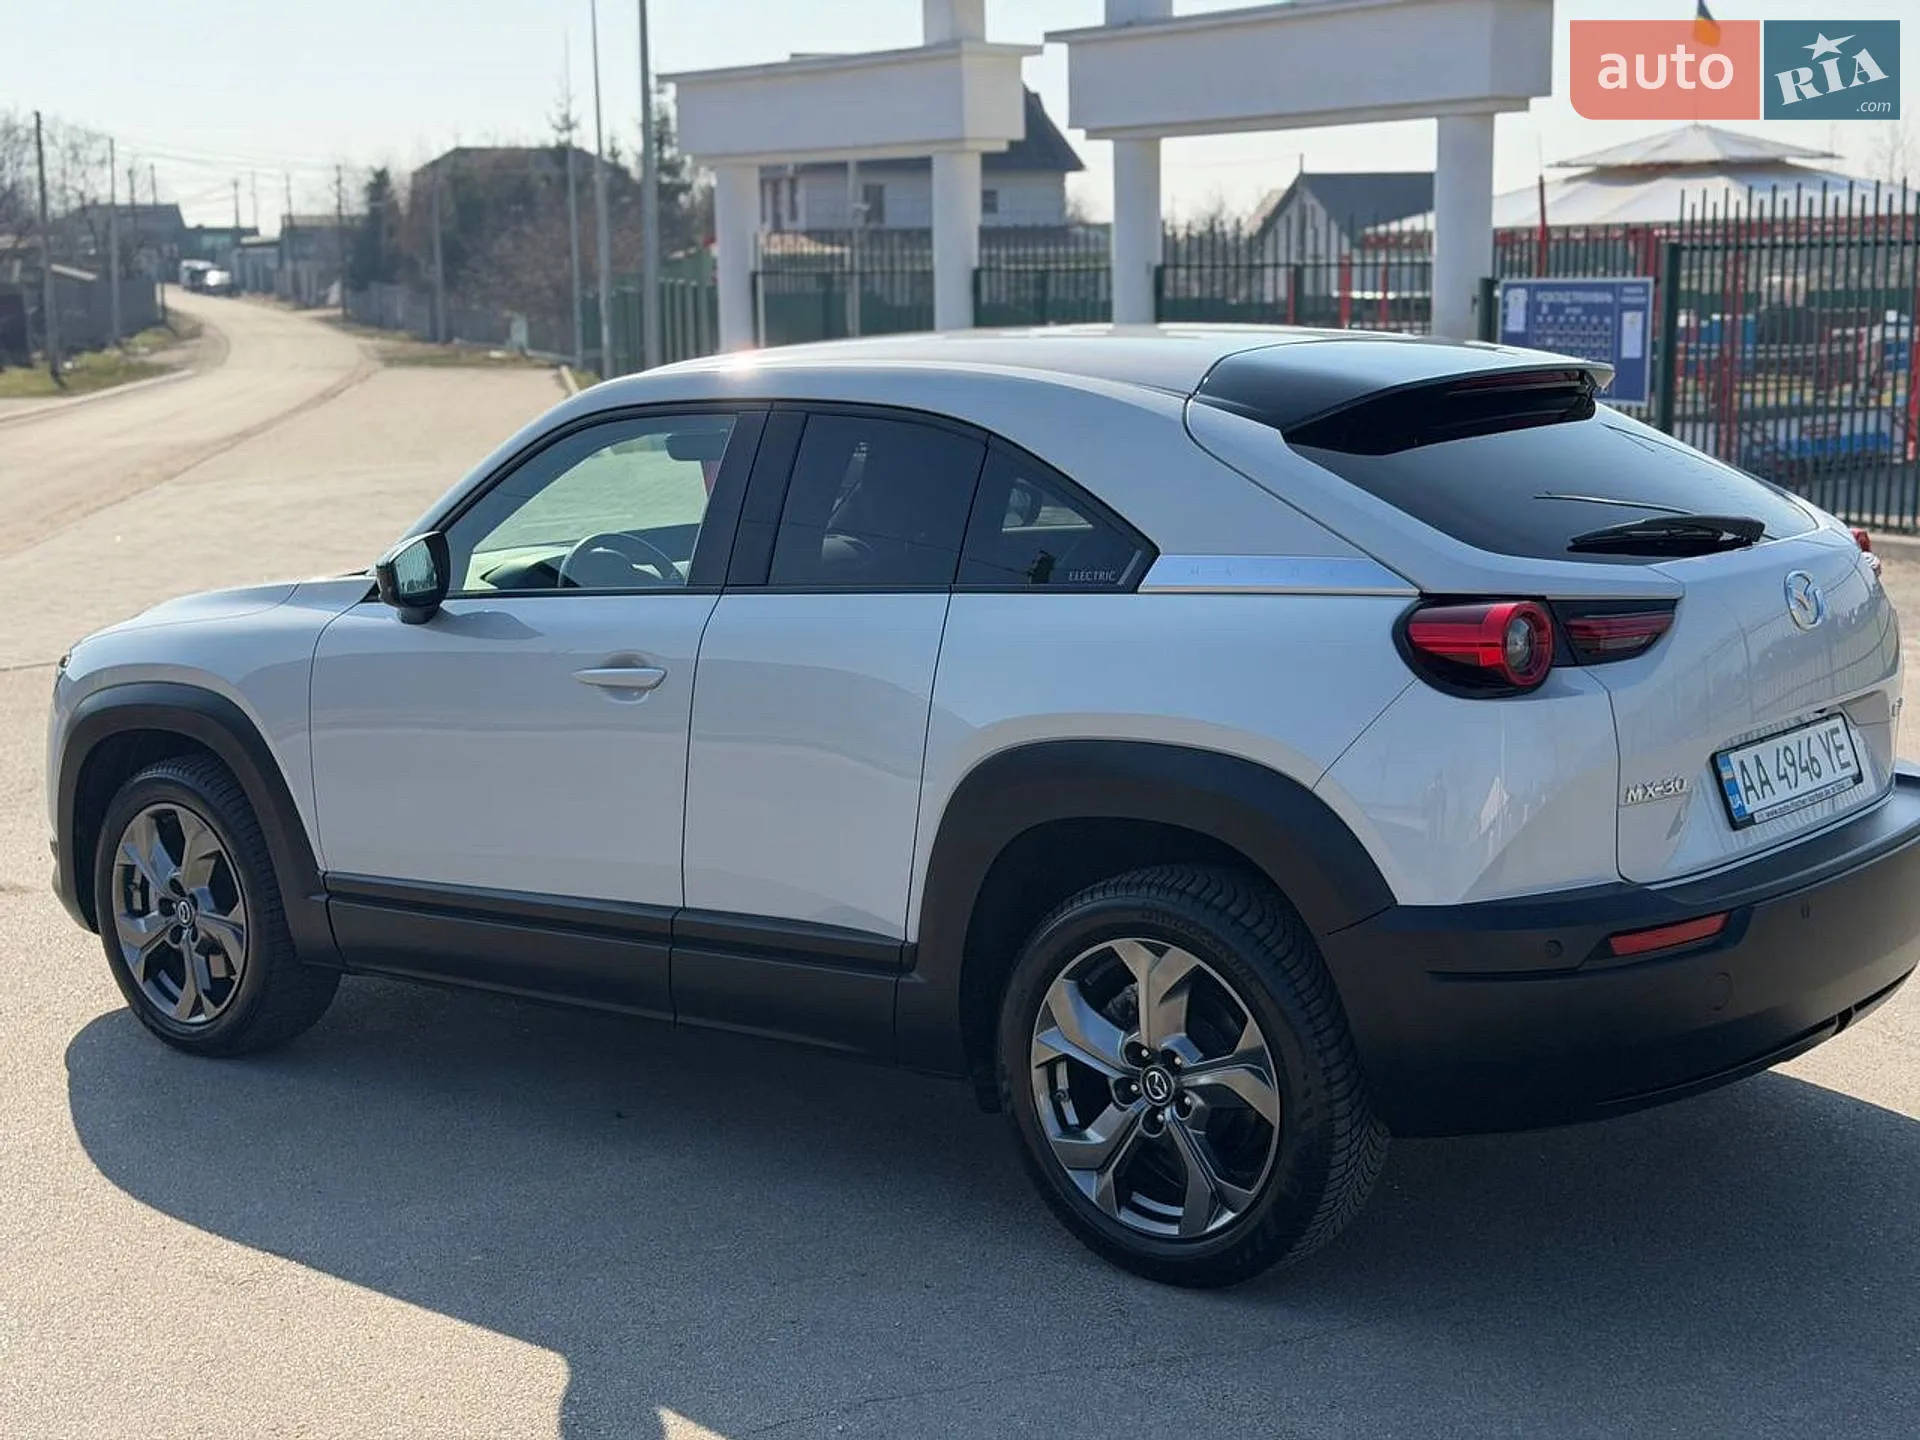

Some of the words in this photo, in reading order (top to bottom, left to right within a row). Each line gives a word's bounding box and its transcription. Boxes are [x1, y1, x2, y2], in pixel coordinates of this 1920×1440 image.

[1068, 570, 1117, 581] ELECTRIC
[1739, 754, 1776, 804] AA
[1775, 736, 1822, 790] 4946
[1818, 726, 1851, 773] YE
[1624, 776, 1688, 803] MX-30
